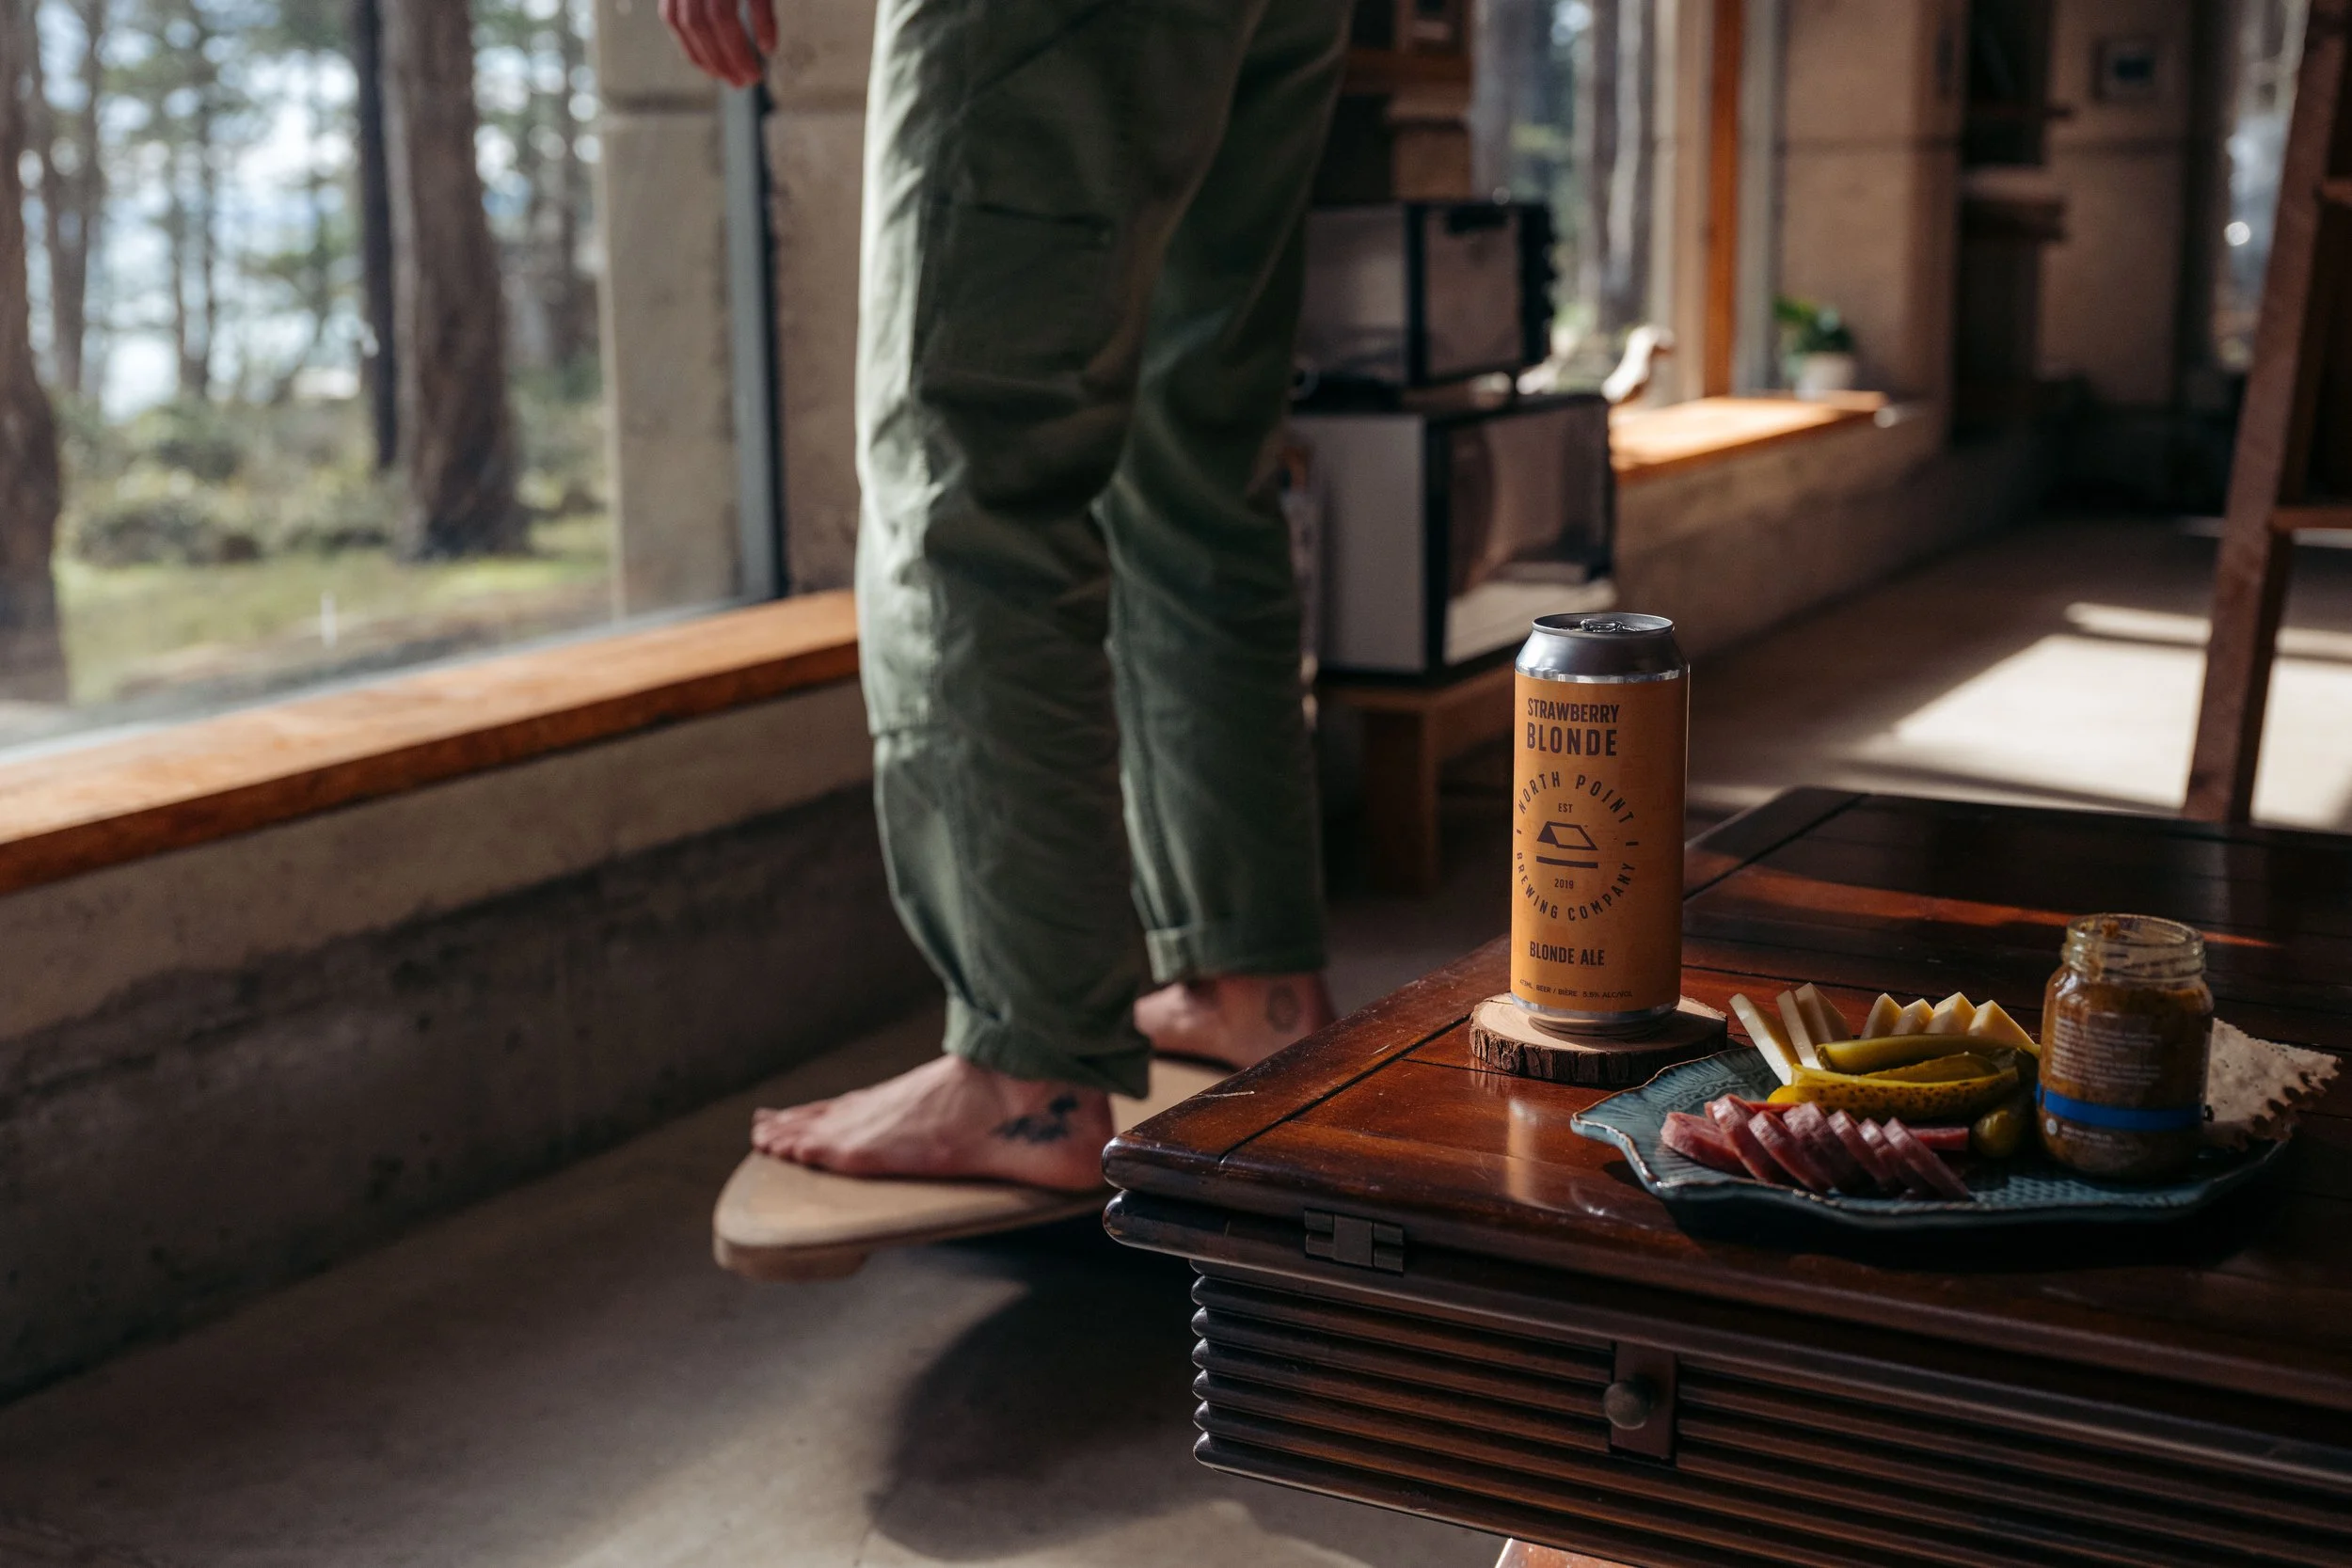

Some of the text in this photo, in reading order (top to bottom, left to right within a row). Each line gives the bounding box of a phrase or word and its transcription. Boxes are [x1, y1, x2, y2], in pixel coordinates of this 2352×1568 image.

[1527, 697, 1620, 723] STRAWBERRY
[1527, 722, 1617, 756] BLONDE
[1518, 771, 1634, 823] NORTH POINT
[1558, 802, 1574, 814] EST
[1517, 852, 1636, 922] BREWING COMPANY
[1554, 878, 1574, 890] 2019
[1529, 941, 1605, 966] BLONDE ALE
[1535, 984, 1551, 993] BEER
